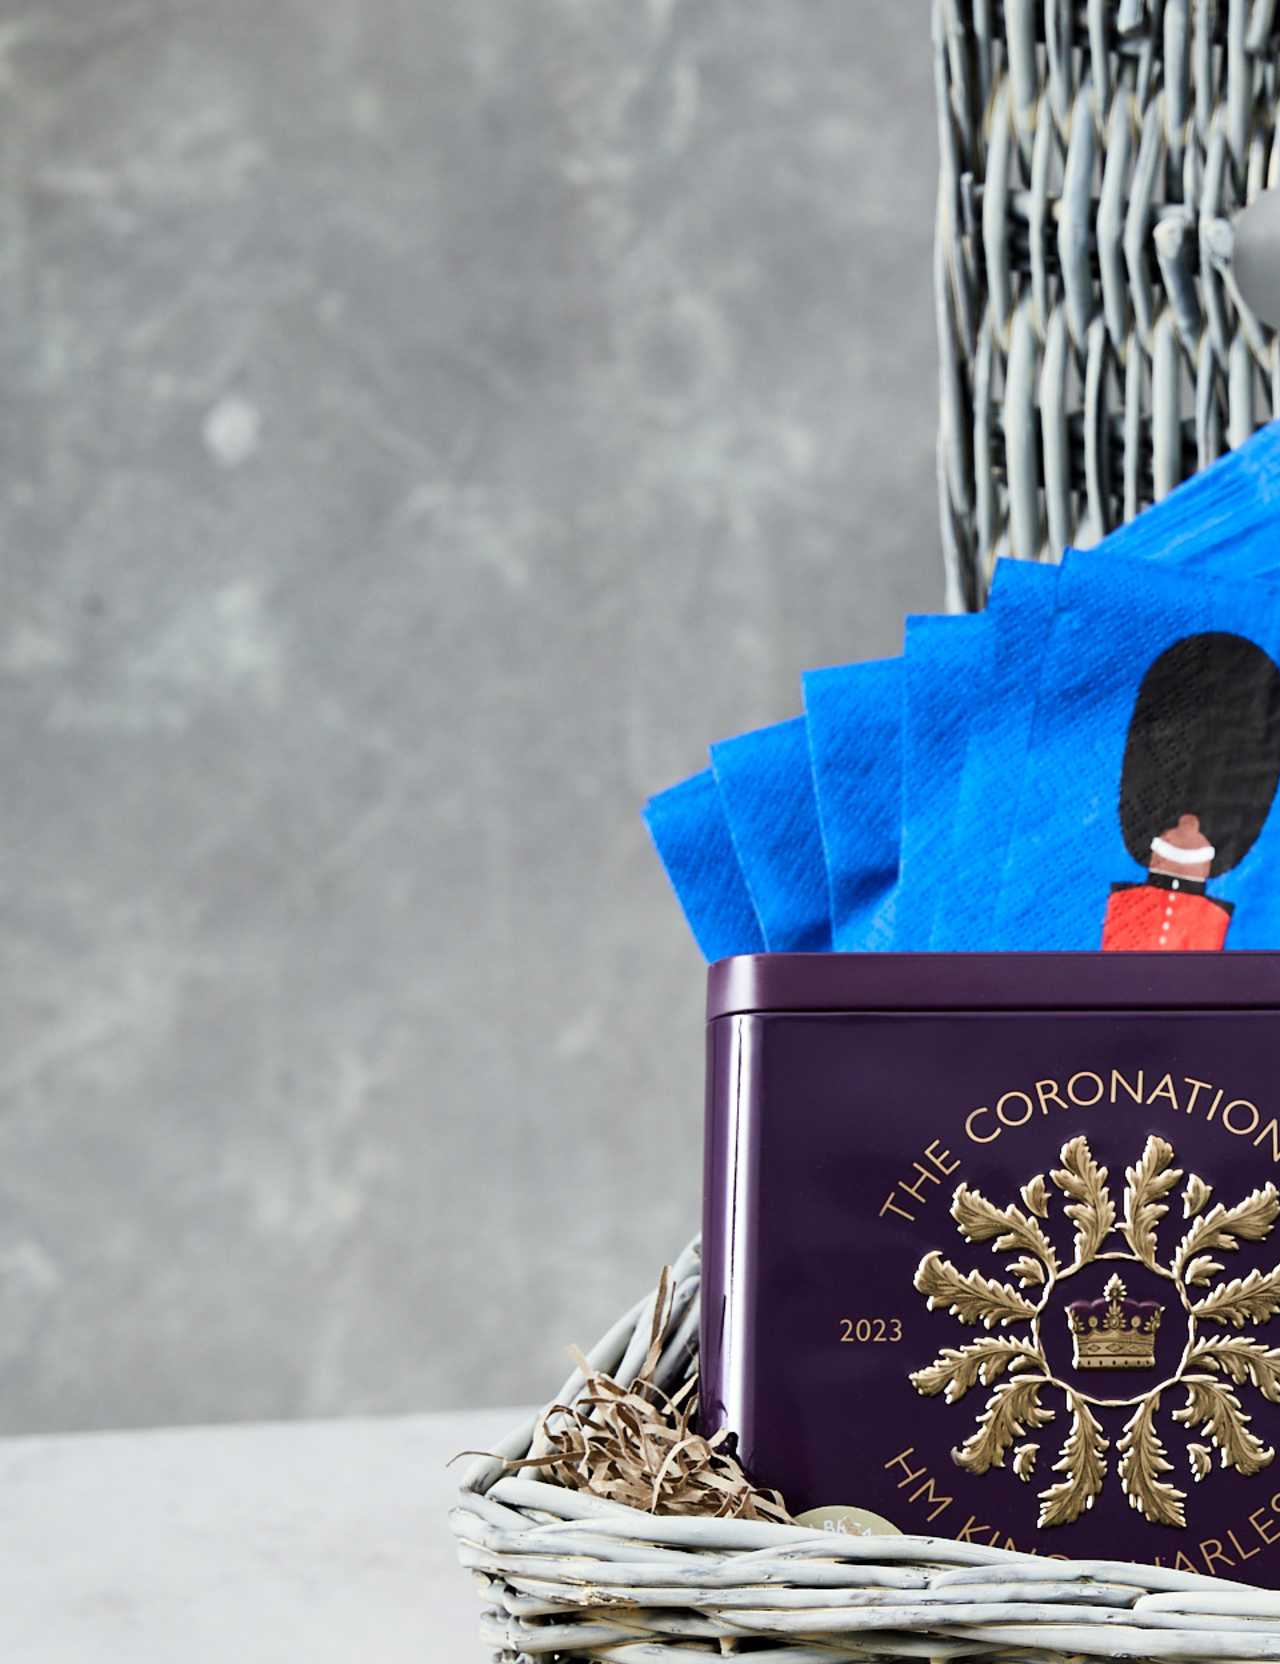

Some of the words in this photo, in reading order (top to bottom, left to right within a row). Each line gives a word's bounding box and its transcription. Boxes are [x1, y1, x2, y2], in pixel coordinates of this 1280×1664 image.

[879, 1139, 961, 1221] THE
[839, 1318, 903, 1342] 2023
[884, 1447, 954, 1522] HM
